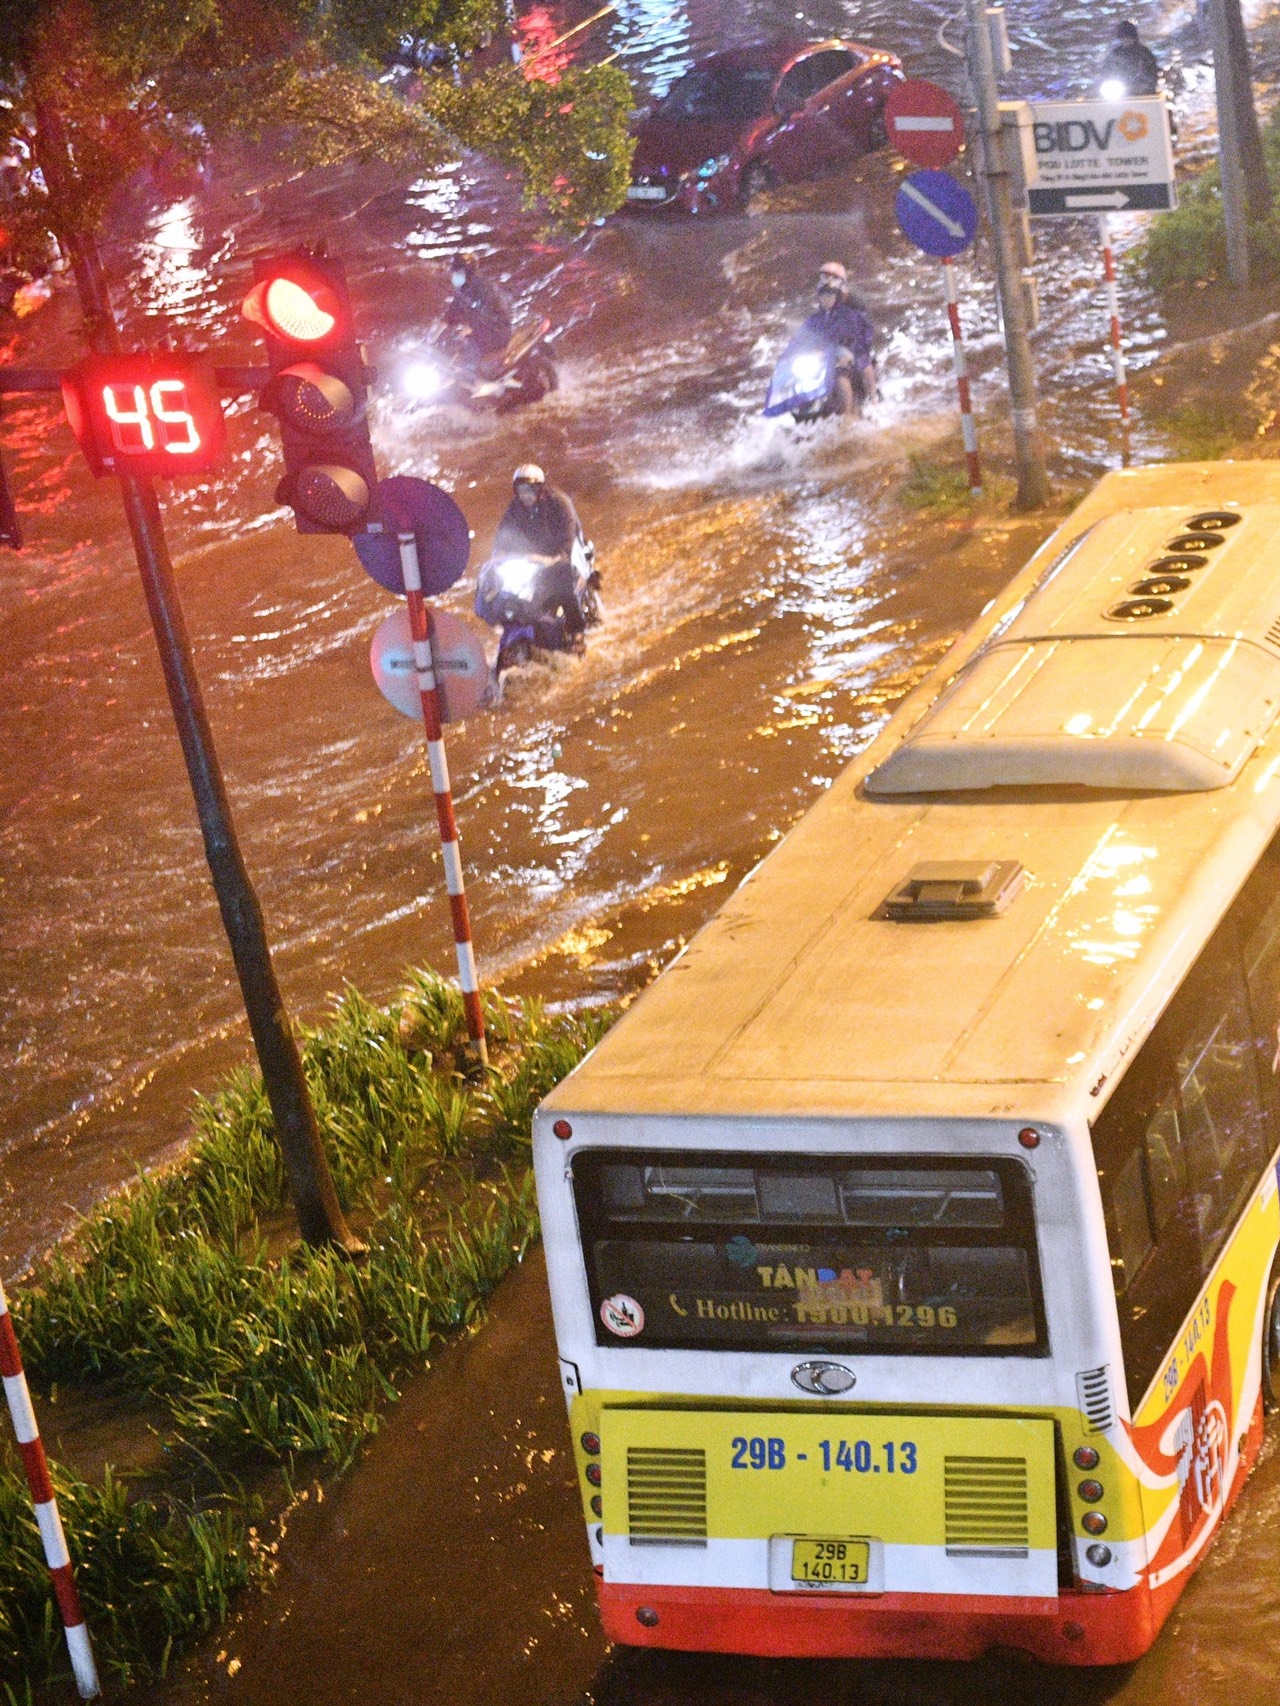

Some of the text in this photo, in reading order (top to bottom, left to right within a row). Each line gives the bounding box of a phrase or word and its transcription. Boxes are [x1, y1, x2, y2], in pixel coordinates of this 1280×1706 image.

[1034, 119, 1117, 153] BIDV
[1064, 158, 1100, 169] LOTTE
[1107, 156, 1149, 167] TOWER
[102, 380, 201, 453] 45
[731, 1436, 787, 1471] 29B
[818, 1439, 919, 1475] 140.13
[814, 1542, 848, 1562] 29B
[802, 1561, 860, 1581] 140.13
